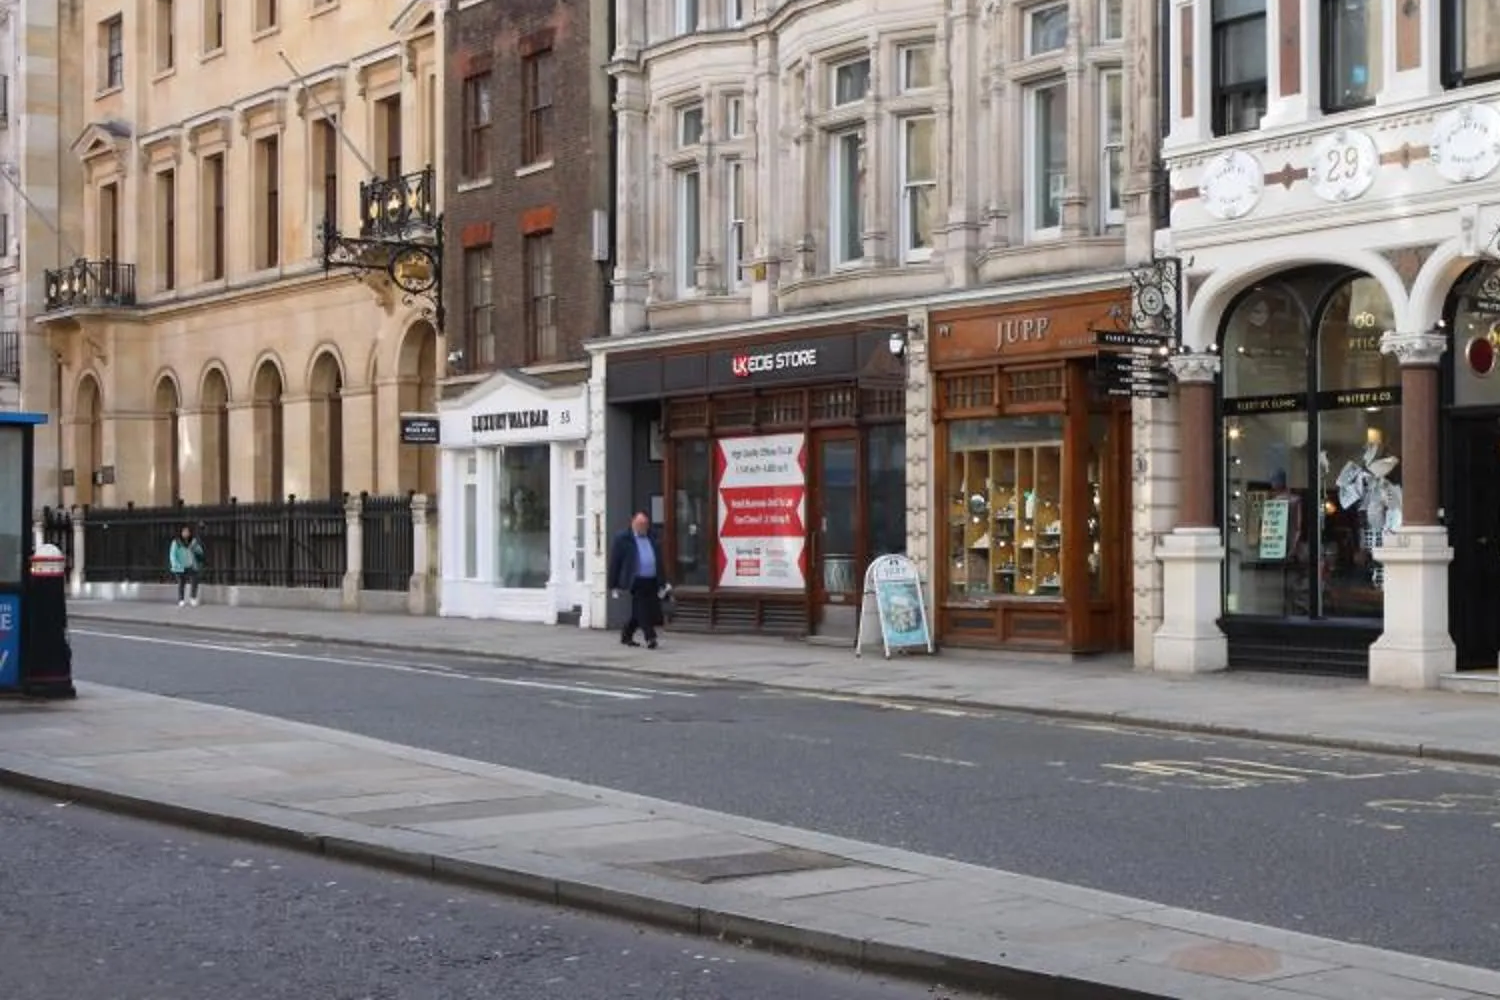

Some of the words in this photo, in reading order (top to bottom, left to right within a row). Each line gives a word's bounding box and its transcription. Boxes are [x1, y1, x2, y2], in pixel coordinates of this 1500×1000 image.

[1326, 147, 1360, 182] 29
[995, 317, 1049, 352] JUPP
[775, 348, 817, 369] STORE
